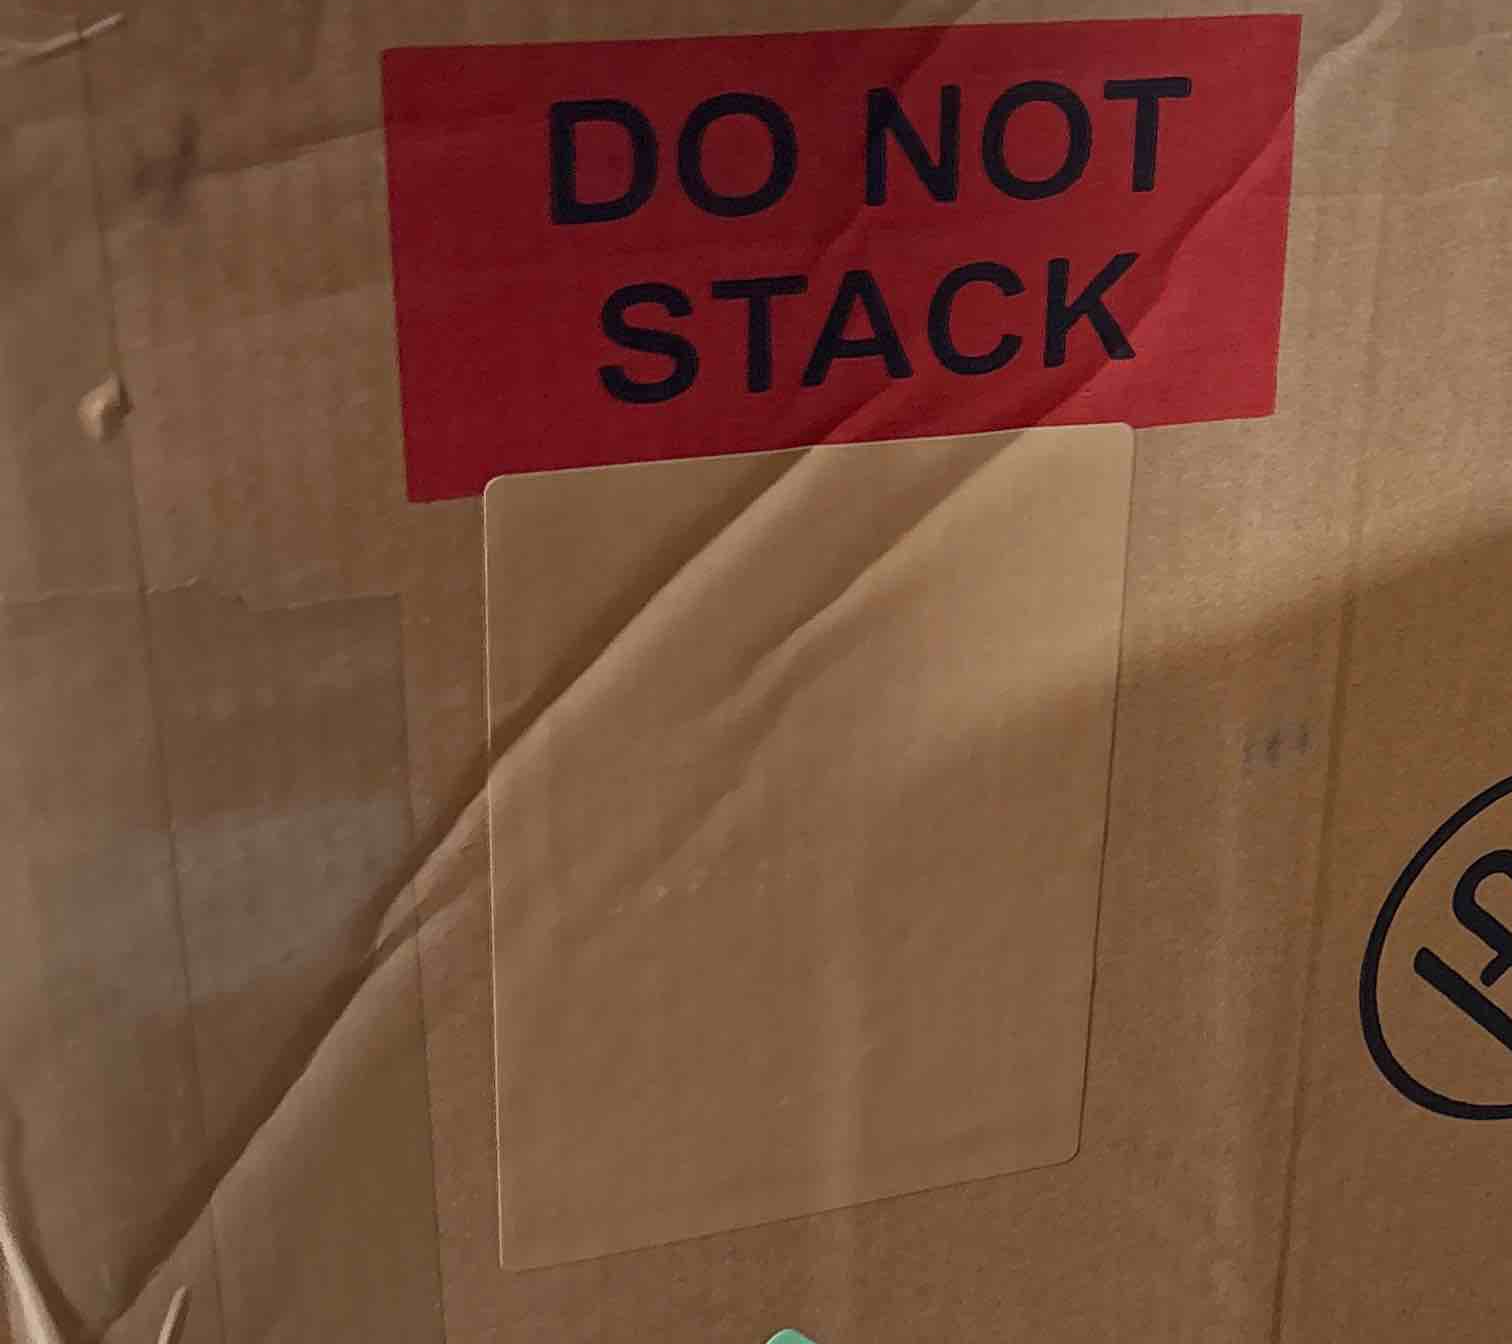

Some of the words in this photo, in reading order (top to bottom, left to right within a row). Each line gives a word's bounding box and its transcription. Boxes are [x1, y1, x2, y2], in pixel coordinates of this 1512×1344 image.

[549, 92, 799, 226] DO
[865, 76, 1193, 207] NOT
[598, 251, 1140, 405] STACK
